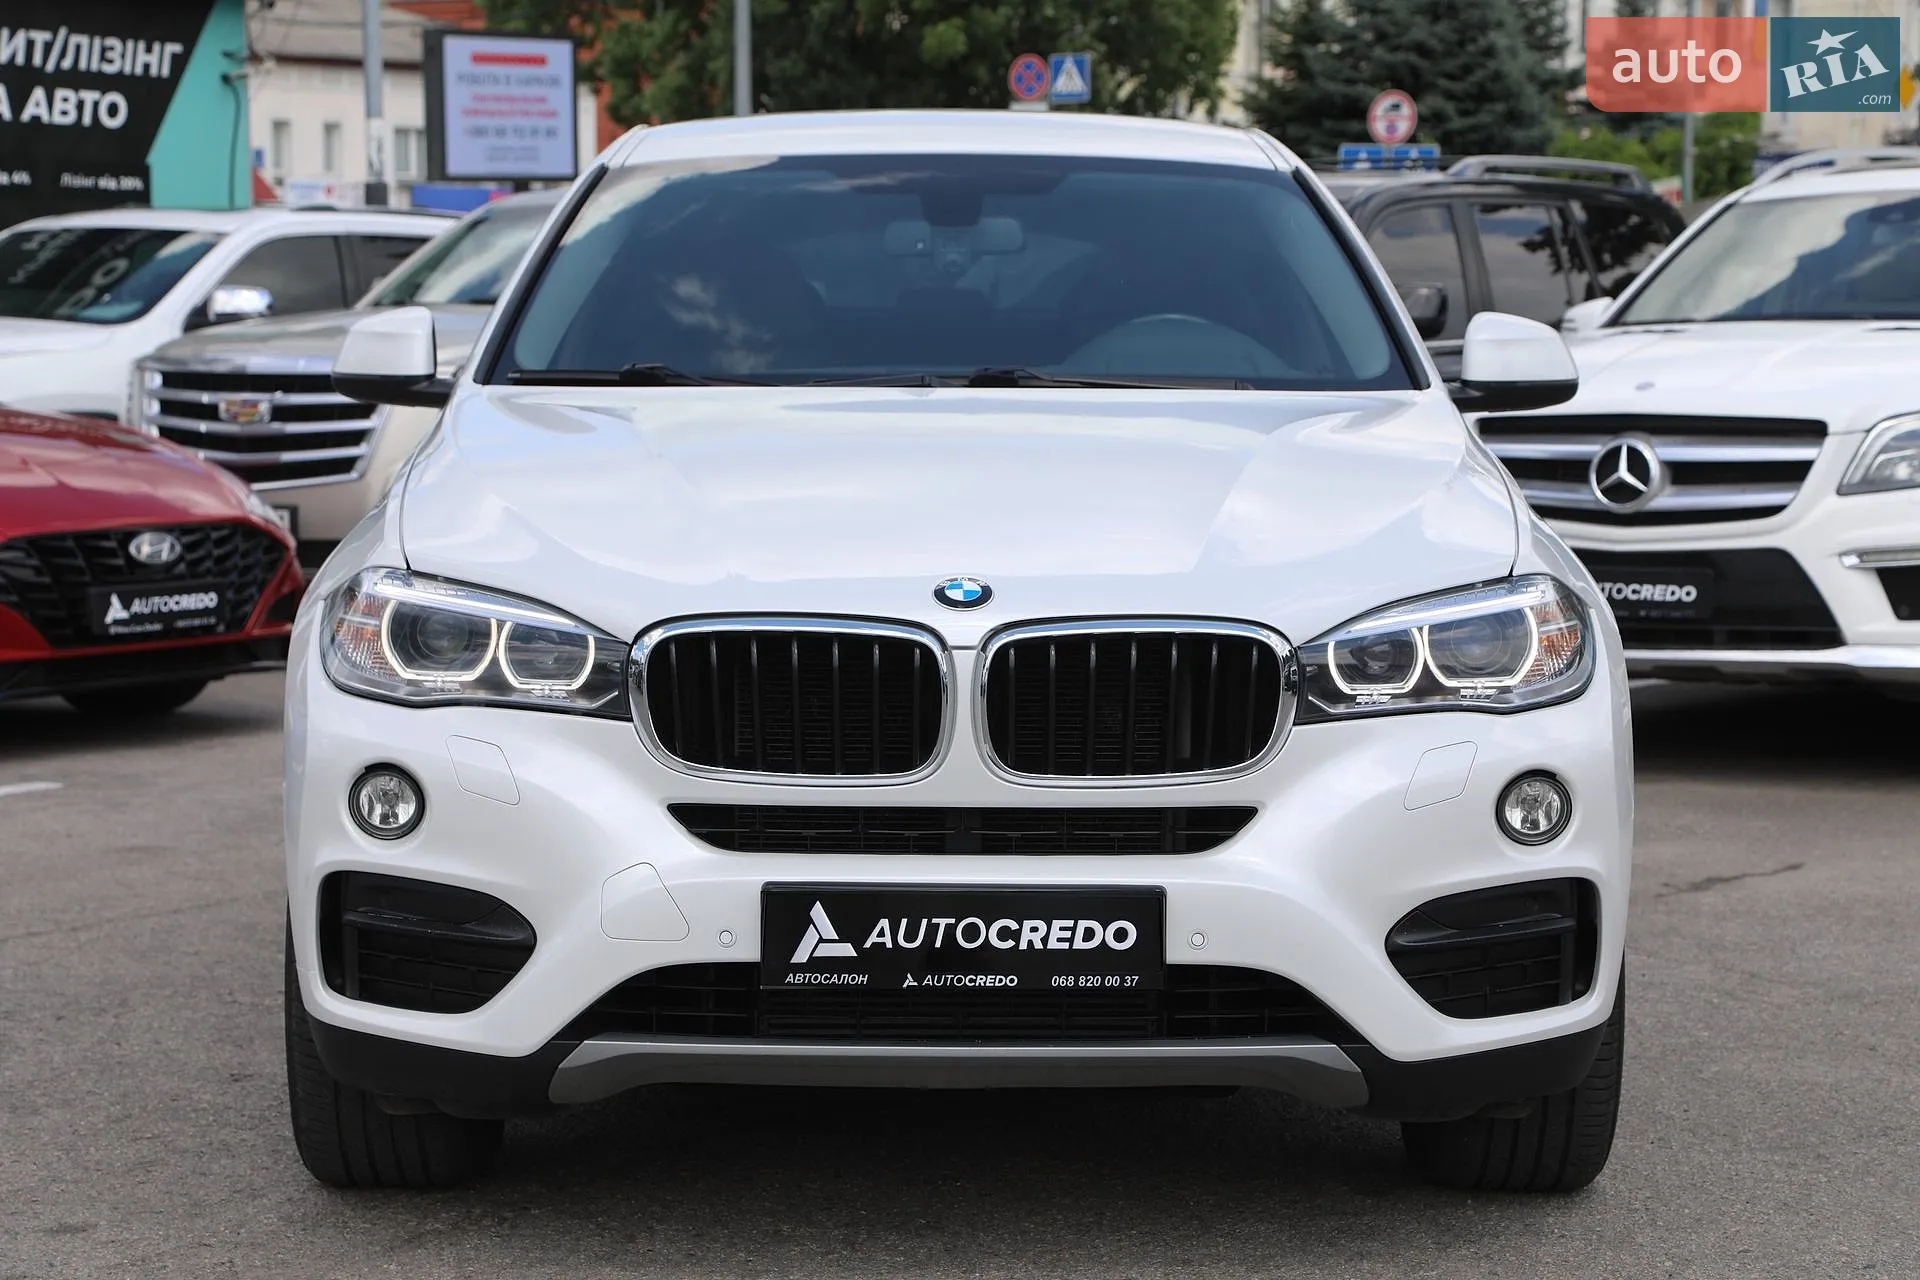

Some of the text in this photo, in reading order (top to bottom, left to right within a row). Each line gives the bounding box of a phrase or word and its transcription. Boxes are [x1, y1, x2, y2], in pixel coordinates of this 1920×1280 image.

[19, 85, 129, 130] АВТО
[1599, 582, 1698, 602] TOCREDO
[129, 591, 219, 616] AUTOCREDO
[863, 916, 1138, 952] AUTOCREDO
[784, 973, 869, 985] АВТОСАЛОН
[921, 974, 1018, 987] AUTOCREDO
[1051, 975, 1139, 987] 068 820 00 37
